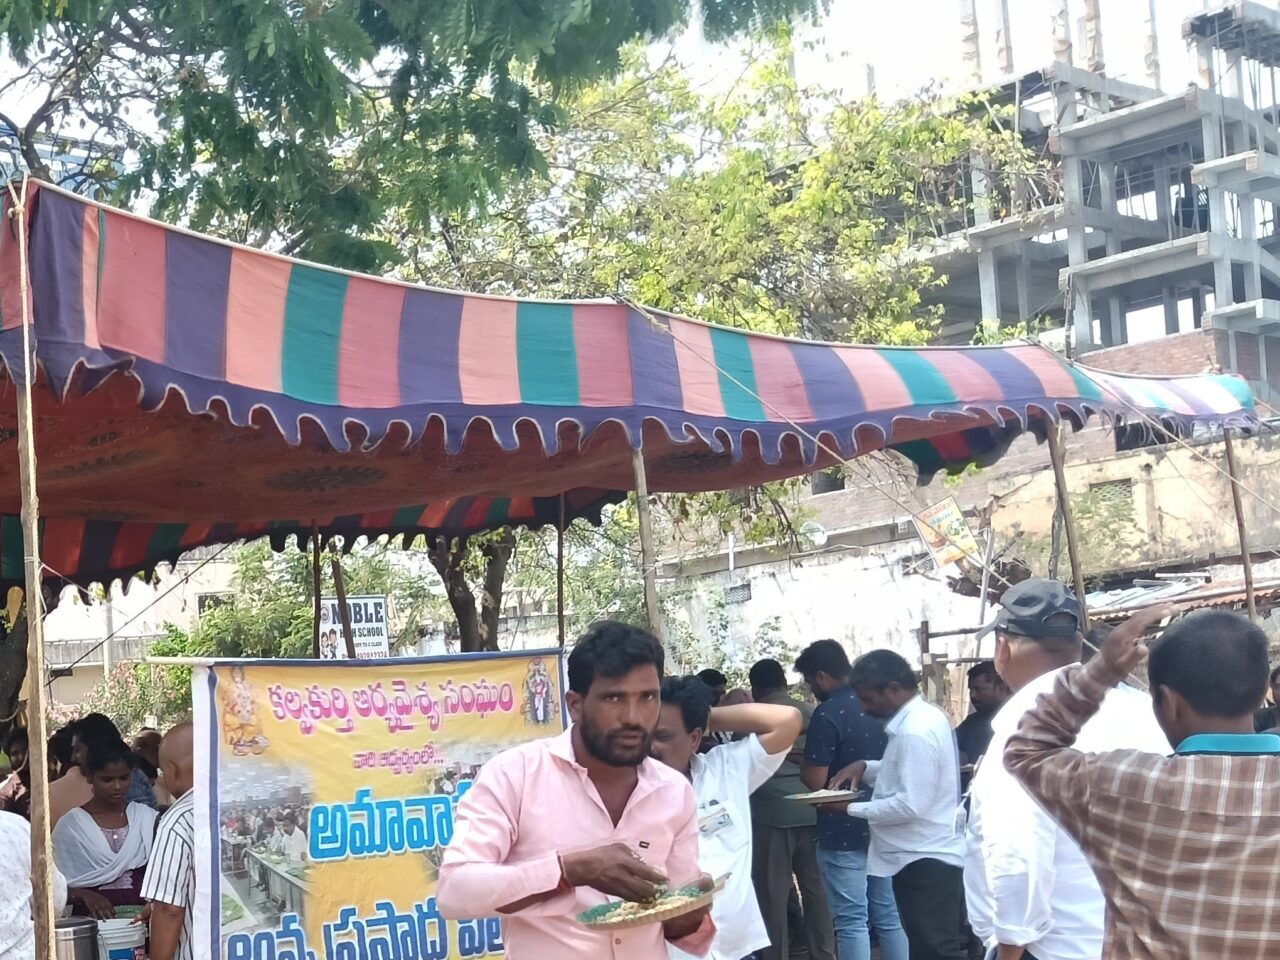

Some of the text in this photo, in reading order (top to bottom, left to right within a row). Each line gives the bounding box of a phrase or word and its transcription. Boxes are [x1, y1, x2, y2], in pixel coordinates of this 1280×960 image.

[339, 627, 384, 639] HH SCHOOL
[267, 684, 354, 735] కల్వకుర్తి
[309, 782, 473, 860] అమావా
